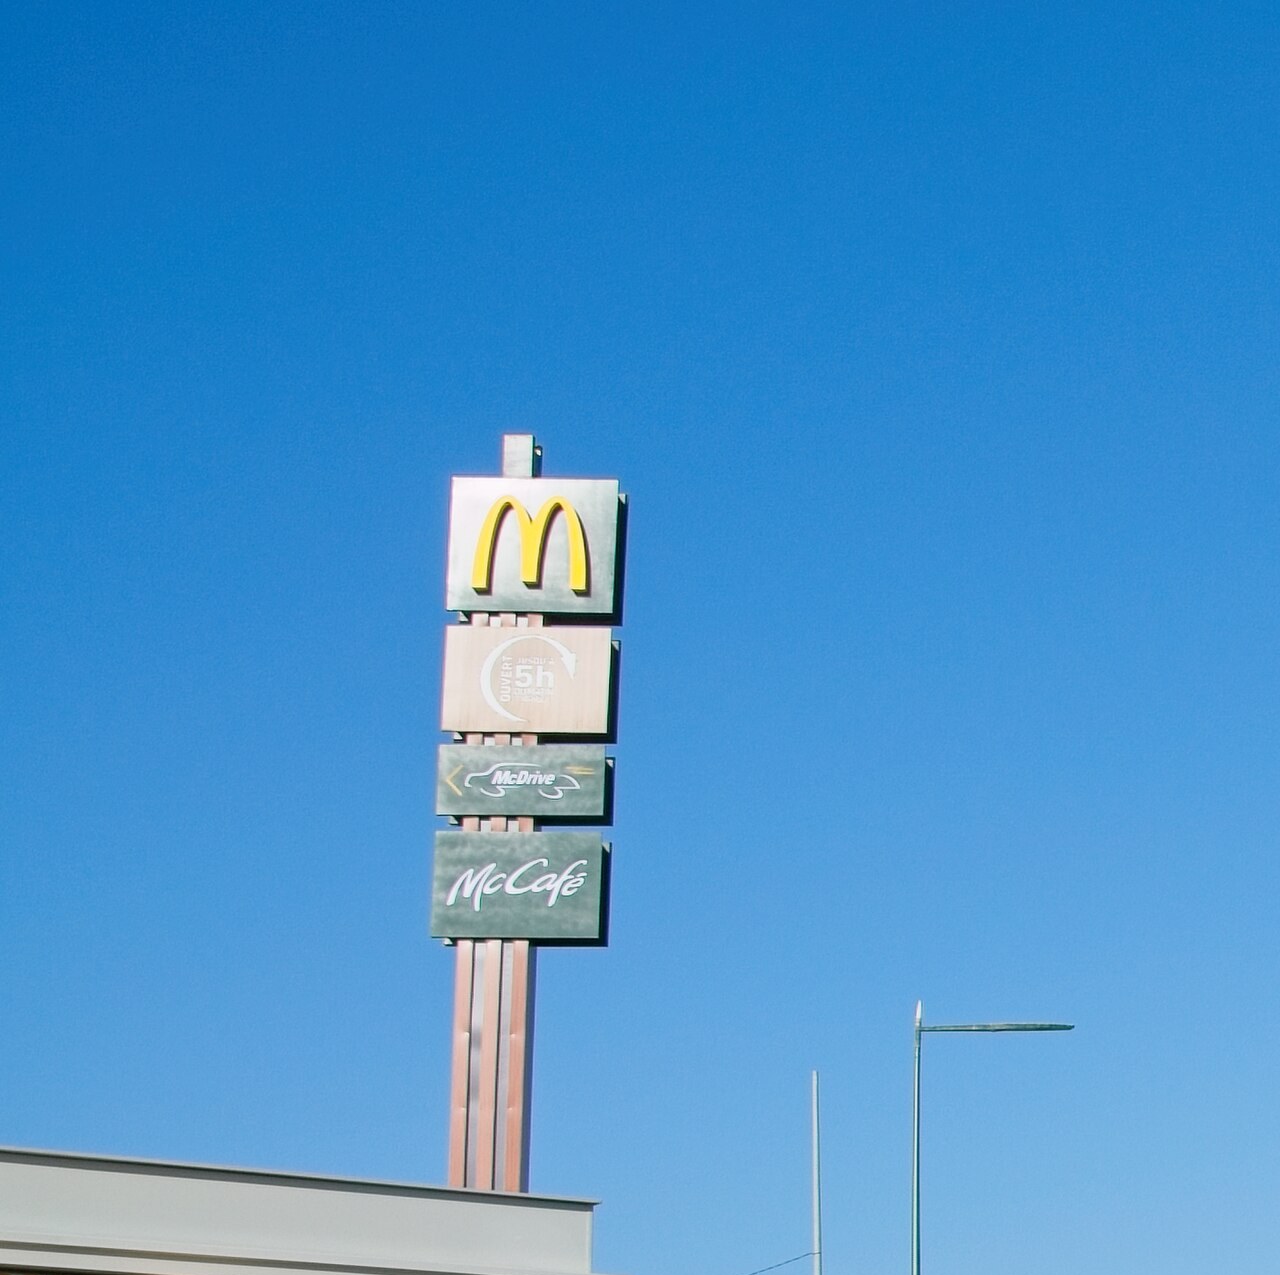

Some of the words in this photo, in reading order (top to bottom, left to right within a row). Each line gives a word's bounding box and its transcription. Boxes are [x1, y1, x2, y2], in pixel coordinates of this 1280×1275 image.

[499, 656, 513, 703] OUVERT
[514, 664, 555, 688] 5h
[491, 770, 556, 785] McDrive
[446, 858, 588, 912] McCafé
